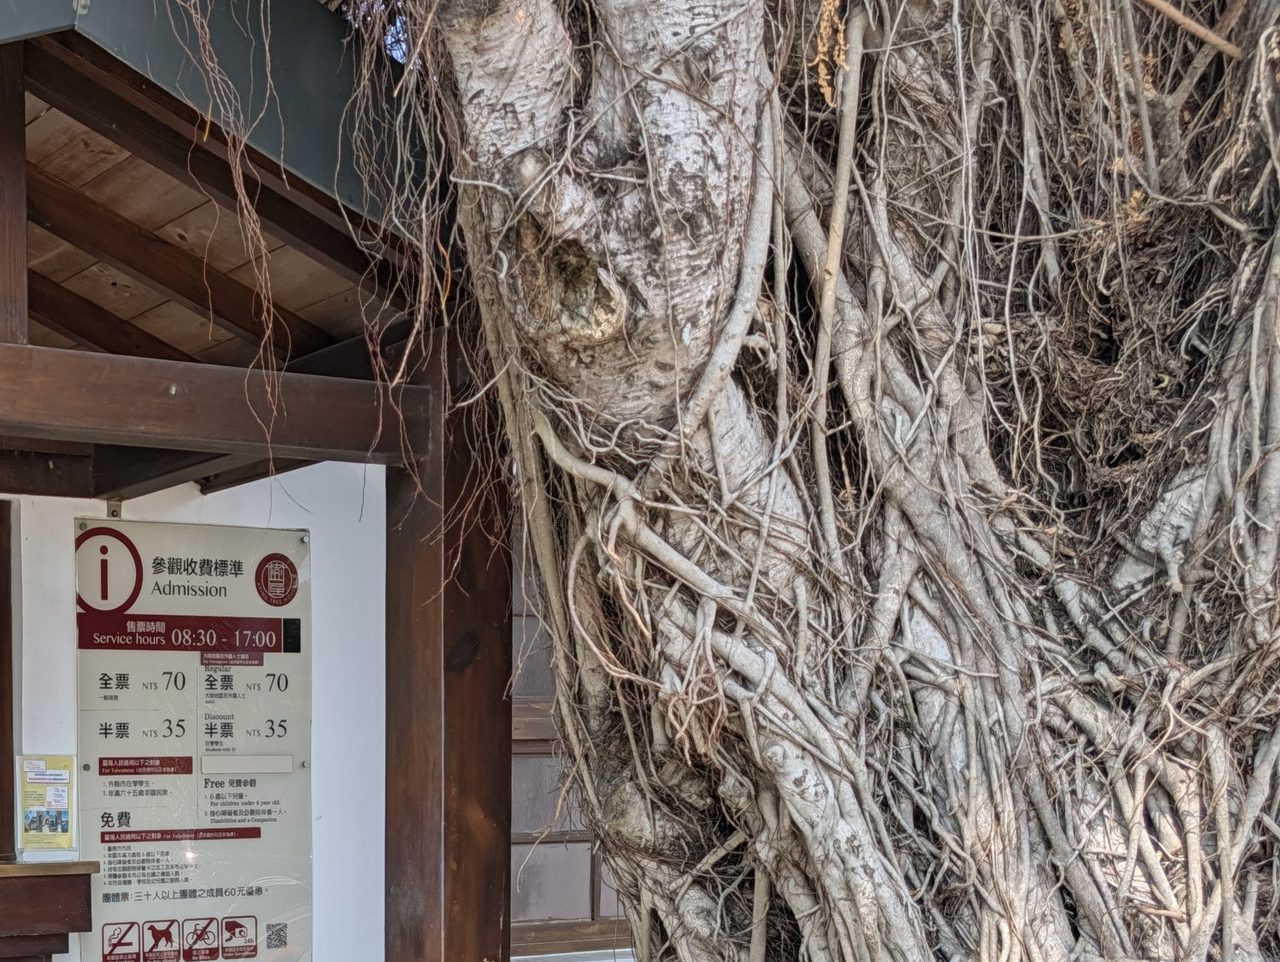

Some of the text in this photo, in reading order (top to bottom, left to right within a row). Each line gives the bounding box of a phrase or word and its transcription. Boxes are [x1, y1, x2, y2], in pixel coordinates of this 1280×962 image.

[152, 556, 244, 578] 參觀收費標準
[151, 579, 227, 598] Admission
[126, 620, 166, 633] 售票時間
[93, 632, 166, 645] Service hours
[171, 628, 217, 646] 08:30
[234, 628, 276, 648] 17:00
[98, 673, 130, 690] 全票
[161, 671, 186, 691] 70
[204, 674, 234, 691] 全票
[265, 673, 289, 692] 70
[98, 722, 130, 739] 半票
[162, 719, 186, 738] 35
[204, 721, 234, 738] 半票
[265, 719, 288, 738] 35
[204, 779, 225, 788] Free
[101, 811, 131, 828] 免費
